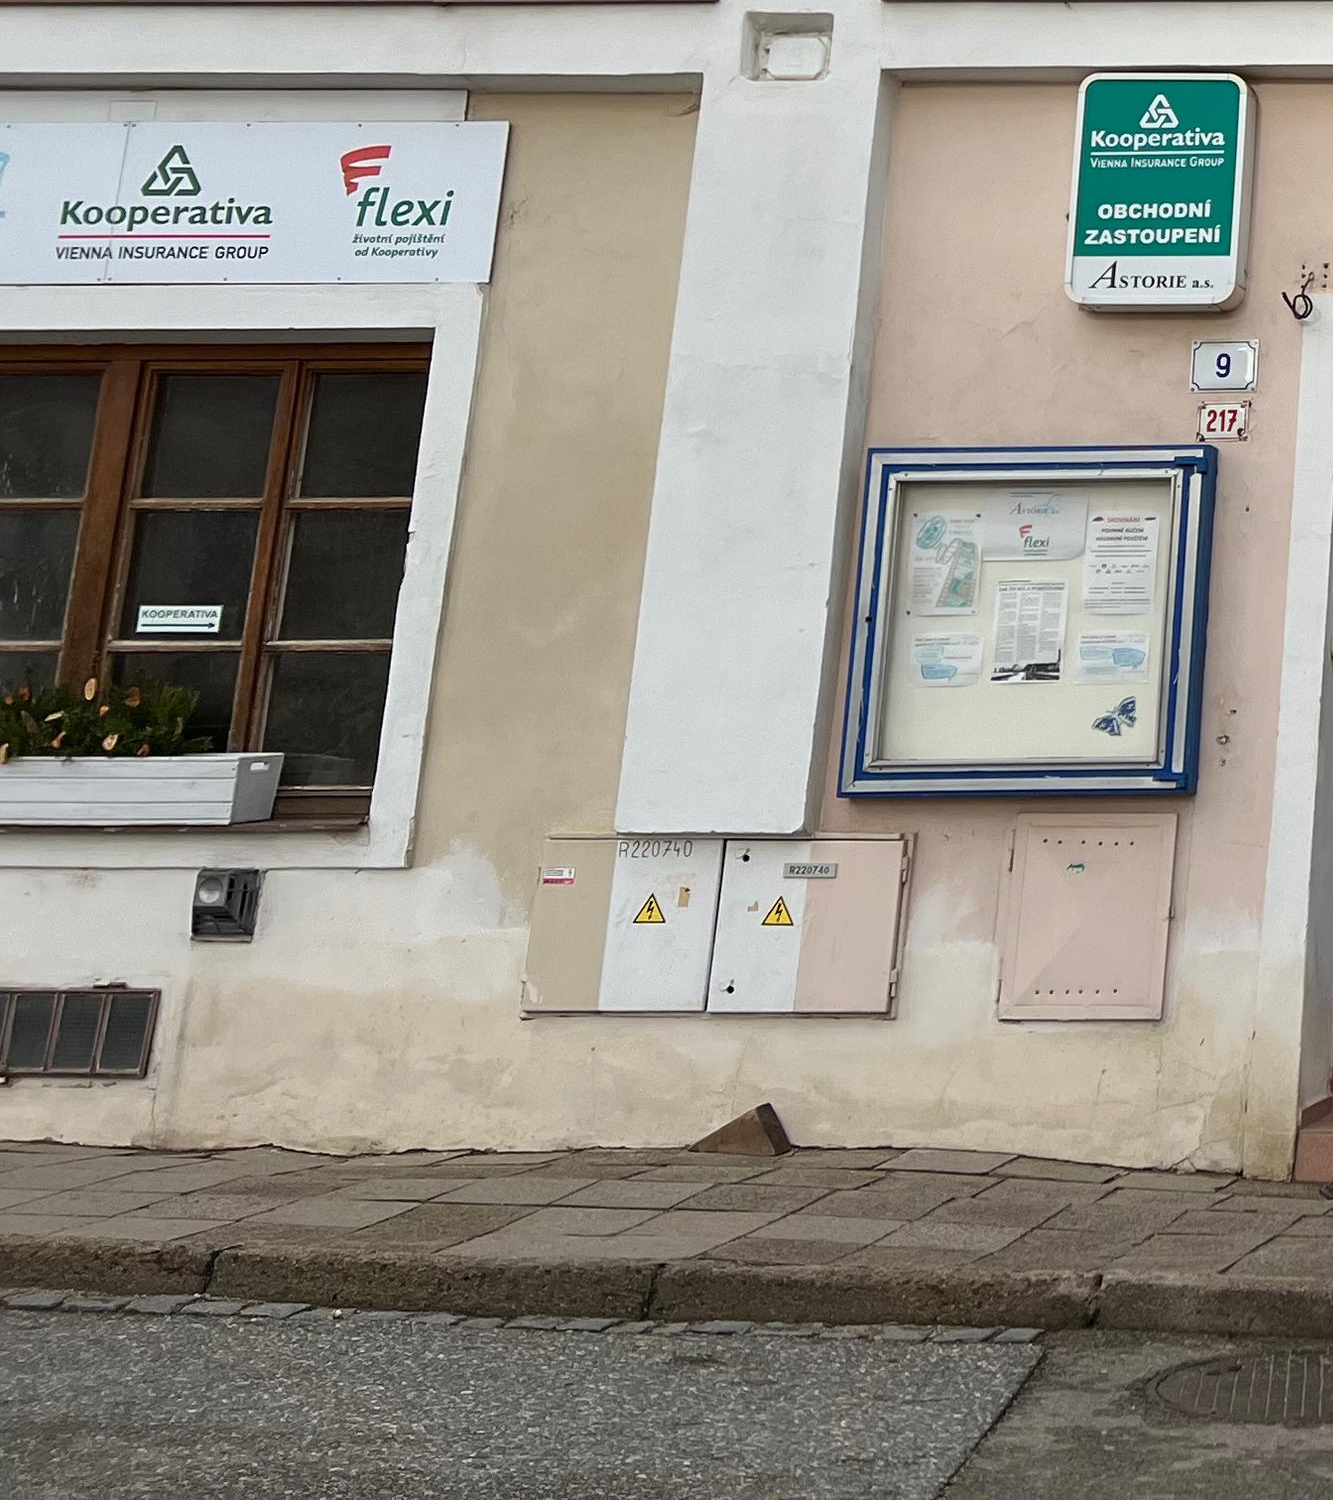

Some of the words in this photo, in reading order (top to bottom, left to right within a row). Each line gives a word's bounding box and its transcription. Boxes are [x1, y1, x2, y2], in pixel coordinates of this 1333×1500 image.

[1091, 128, 1225, 151] Kooperativa
[60, 198, 272, 231] Kooperativa
[356, 187, 455, 227] flexi
[1097, 200, 1212, 219] OBCHODNÍ
[352, 234, 393, 244] životní
[394, 234, 445, 246] pojištění
[1084, 225, 1221, 244] ZASTOUPENÍ
[56, 246, 112, 260] VIENNA
[118, 246, 209, 260] INSURANCE
[215, 246, 270, 260] GROUP
[355, 247, 369, 257] od
[371, 247, 439, 258] Kooperativy
[1088, 260, 1187, 289] ASTORIE
[1191, 278, 1214, 289] a.s.
[1216, 353, 1231, 378] 9
[1206, 409, 1238, 432] 217
[1023, 536, 1049, 548] flexi
[141, 609, 218, 619] KOOPERATIVA
[619, 840, 693, 858] R220740
[789, 866, 830, 875] R220740
